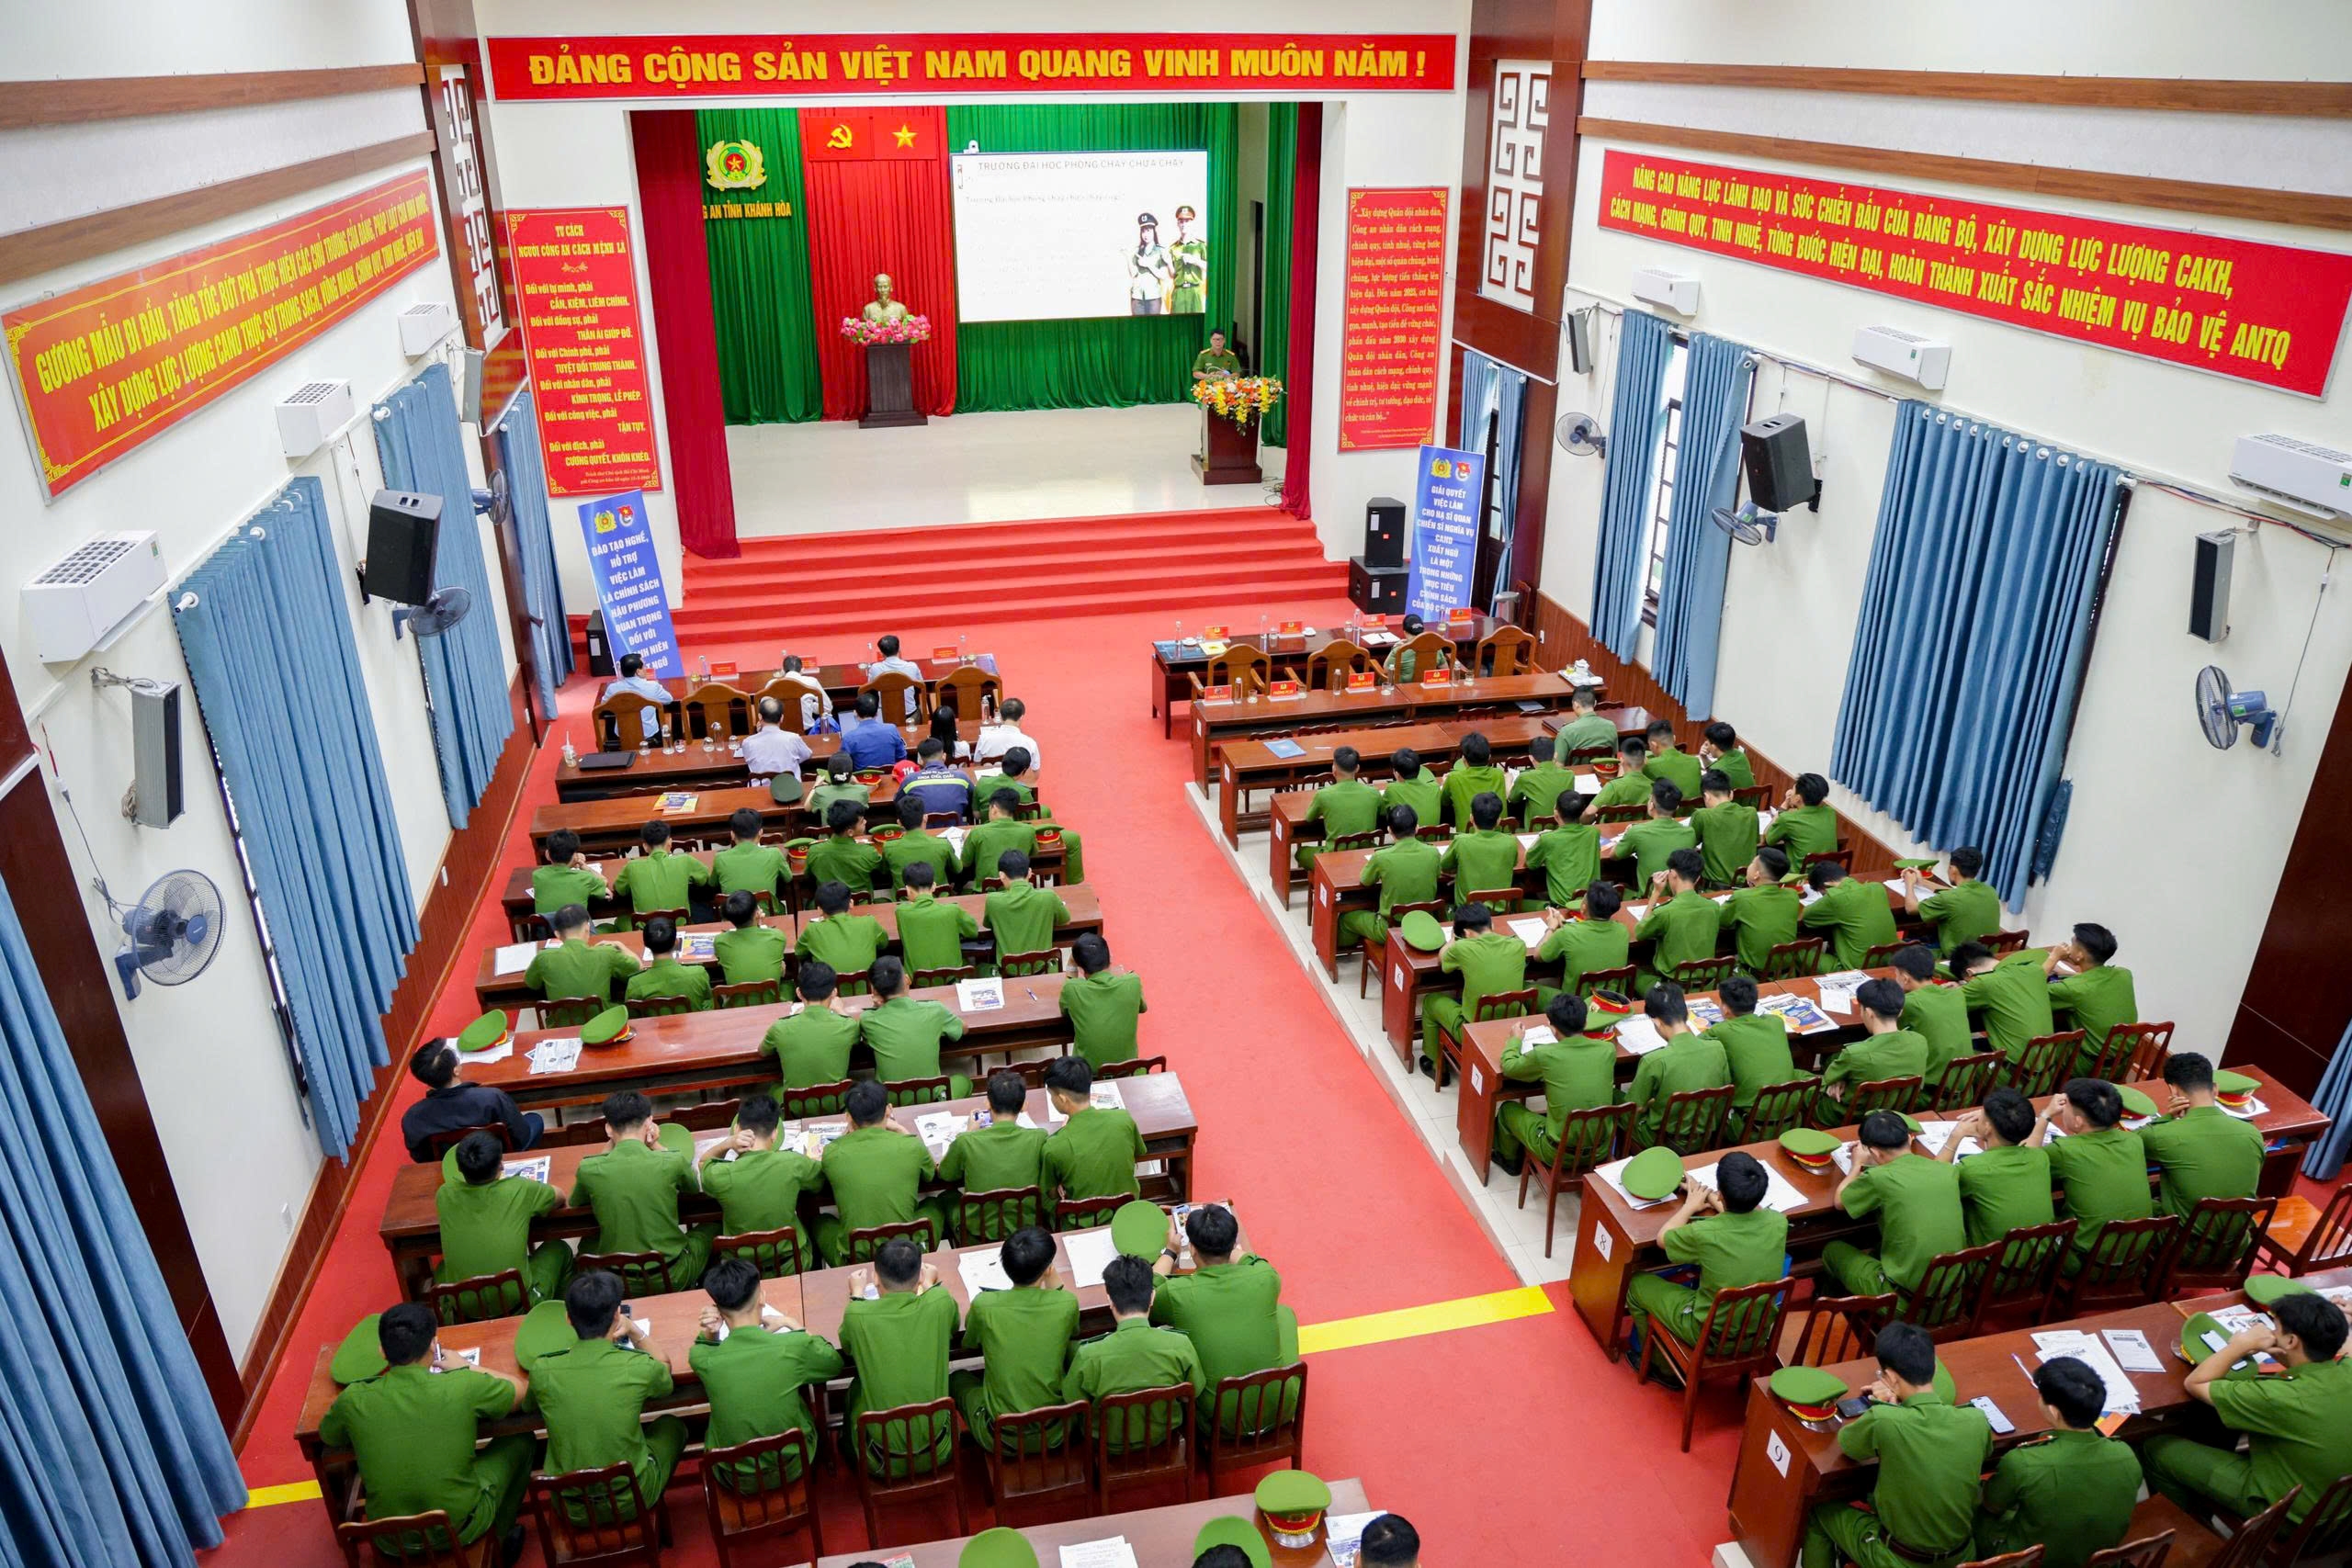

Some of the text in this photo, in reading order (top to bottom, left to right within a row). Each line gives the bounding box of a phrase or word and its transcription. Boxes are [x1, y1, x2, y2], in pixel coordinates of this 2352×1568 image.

[529, 42, 1425, 88] ĐẢNG CỘNG SẢN VIỆT NAM QUANG VINH MUÔN NĂM !
[709, 204, 722, 219] AN
[1633, 163, 2233, 300] NÂNG CAO NĂNG LỰC LÃNH ĐẠO VÀ SỨC CHIẾN ĐẤU CỦA ĐẢNG BỘ, XÂY DỰNG LỰC LƯỢNG CAKH,
[1611, 193, 2290, 370] CÁCH MẠNG, CHÍNH QUY, TINH NHUỆ, TỪNG BƯỚC HIỆN ĐẠI, HOÀN THÀNH XUẤT SẮC NHIỆM VỤ BẢO VỆ ANTQ
[35, 338, 92, 393] GƯƠNG
[89, 312, 125, 368] MẪU
[123, 315, 141, 355] ĐI
[138, 297, 172, 346] ĐẦU,
[167, 291, 201, 333] TĂNG
[197, 275, 220, 321] TỐC
[218, 272, 239, 311] BỨT
[237, 263, 258, 303] PHÁ
[88, 382, 120, 432] XÂY
[119, 369, 158, 419] DỰNG
[155, 356, 181, 400] LỰC
[178, 339, 216, 384] LƯỢNG
[213, 325, 242, 365] CAND
[1600, 1235, 1606, 1250] 8
[1773, 1445, 1782, 1461] 9
